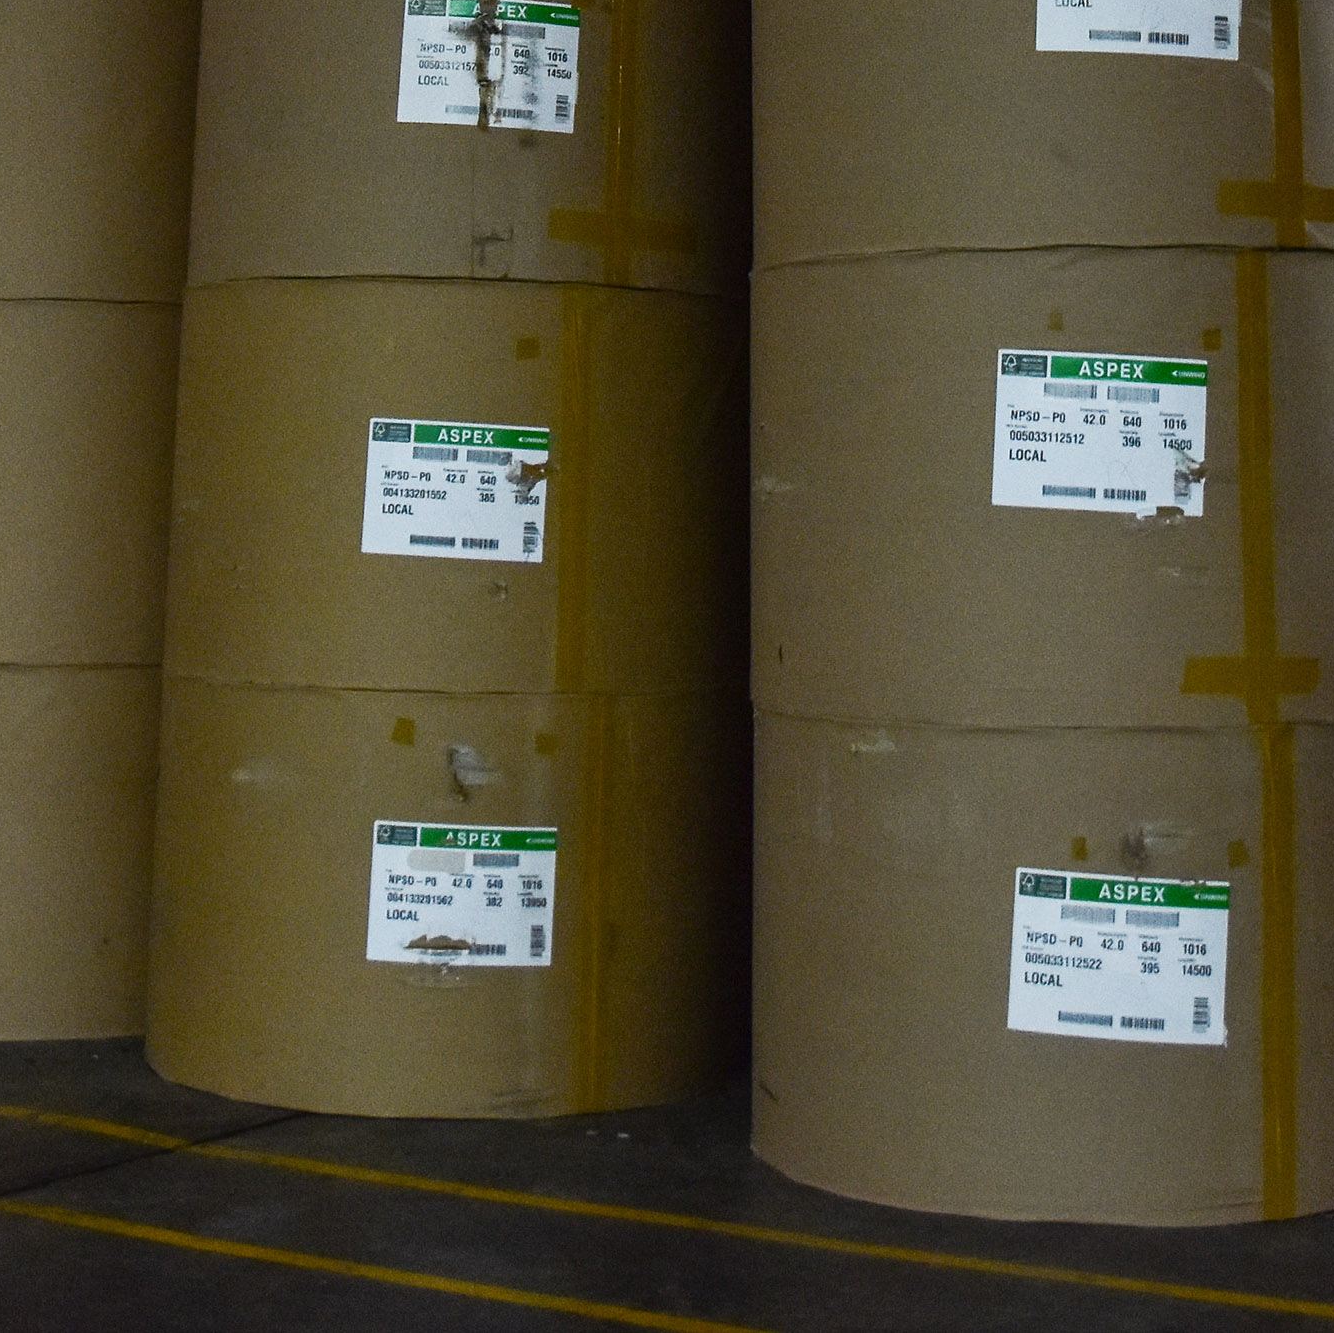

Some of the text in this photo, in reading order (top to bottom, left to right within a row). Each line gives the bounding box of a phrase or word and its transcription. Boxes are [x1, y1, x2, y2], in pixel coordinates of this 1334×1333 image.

[473, 5, 527, 19] APEX
[514, 48, 530, 59] 640
[547, 52, 568, 63] 1016
[513, 65, 530, 76] 392
[547, 68, 572, 80] 14550
[418, 75, 449, 86] LOCAL
[1079, 360, 1145, 379] ASPEX
[1083, 414, 1106, 426] 42.0
[1122, 416, 1142, 428] 640
[1163, 418, 1187, 431] 1016
[437, 428, 495, 445] ASPEX
[1009, 430, 1193, 451] 005033112512 396 14500
[1009, 448, 1048, 463] LOCAL
[445, 473, 466, 484] 42.0
[480, 476, 497, 487] 640
[383, 488, 448, 501] 004133201552
[382, 504, 414, 516] LOCAL
[446, 832, 502, 847] ASPEX
[452, 878, 473, 889] 42.0
[486, 879, 504, 889] 640
[522, 879, 543, 890] 1016
[1098, 883, 1165, 903] ASPEX
[386, 909, 420, 922] LOCAL
[1100, 938, 1125, 952] 42.0
[1141, 941, 1162, 954] 640
[1182, 943, 1208, 957] 1016
[1024, 952, 1212, 977] 005033112522 395 14500
[1024, 971, 1064, 987] LOCAL
